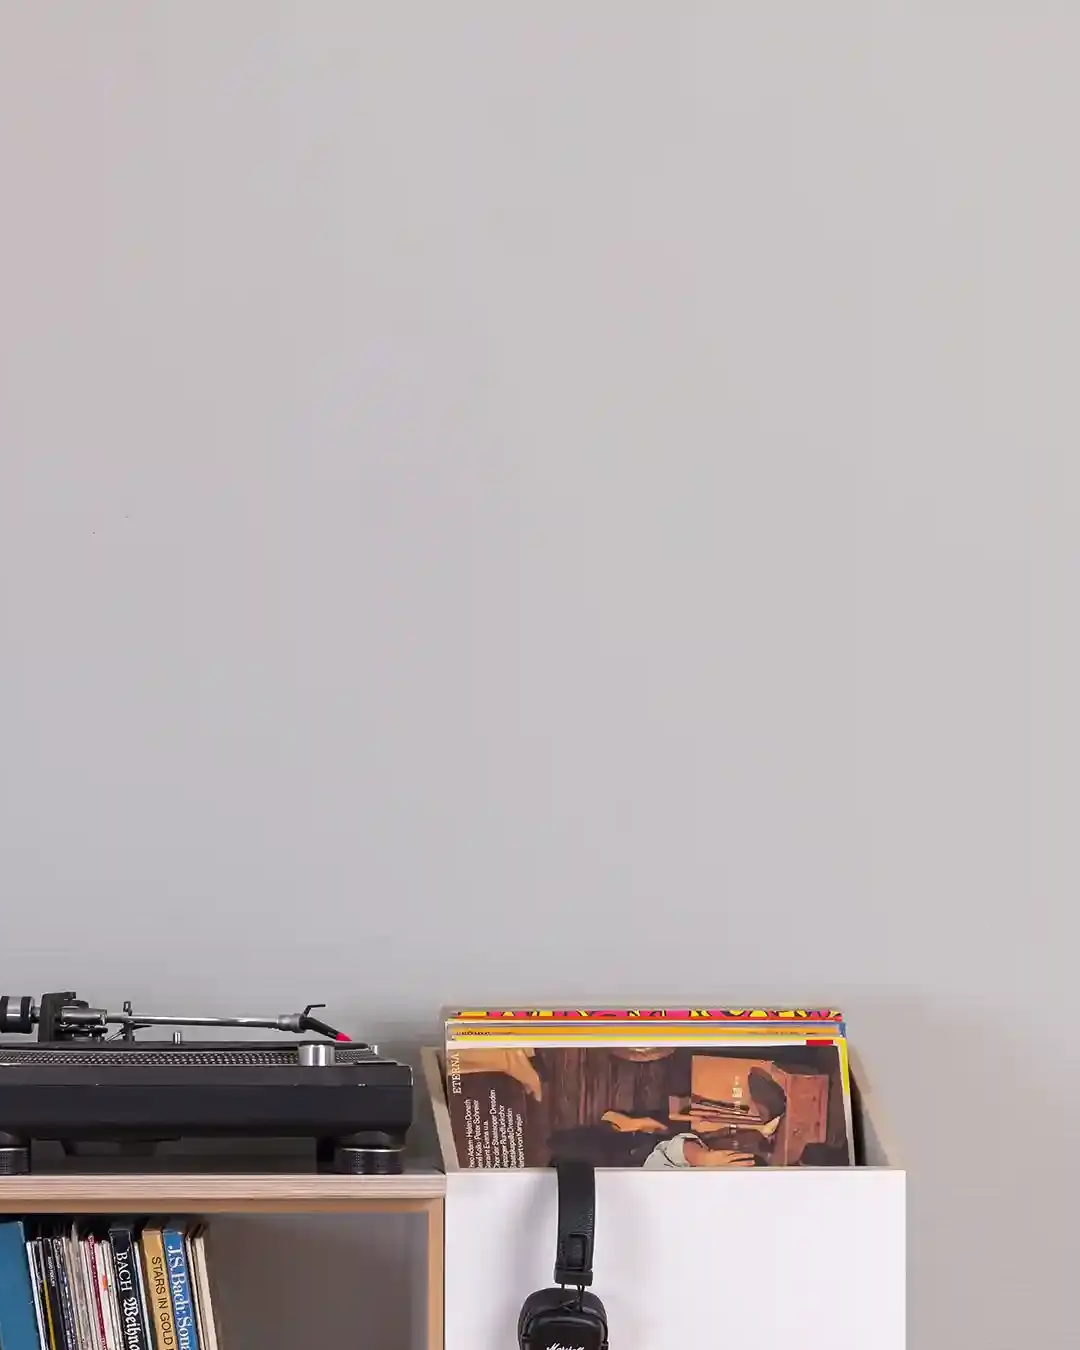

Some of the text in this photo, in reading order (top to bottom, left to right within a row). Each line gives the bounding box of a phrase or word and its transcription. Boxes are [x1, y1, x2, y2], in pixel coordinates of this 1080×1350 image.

[451, 1051, 461, 1094] ETERNA
[489, 1090, 497, 1114] Dresden
[474, 1125, 482, 1139] Peter
[515, 1114, 523, 1136] Karajan
[116, 1251, 132, 1292] BACH
[167, 1244, 185, 1271] J.S.
[151, 1256, 166, 1295] STARS
[158, 1297, 168, 1309] IN
[171, 1272, 192, 1315] Bach:
[160, 1312, 174, 1346] GOLD
